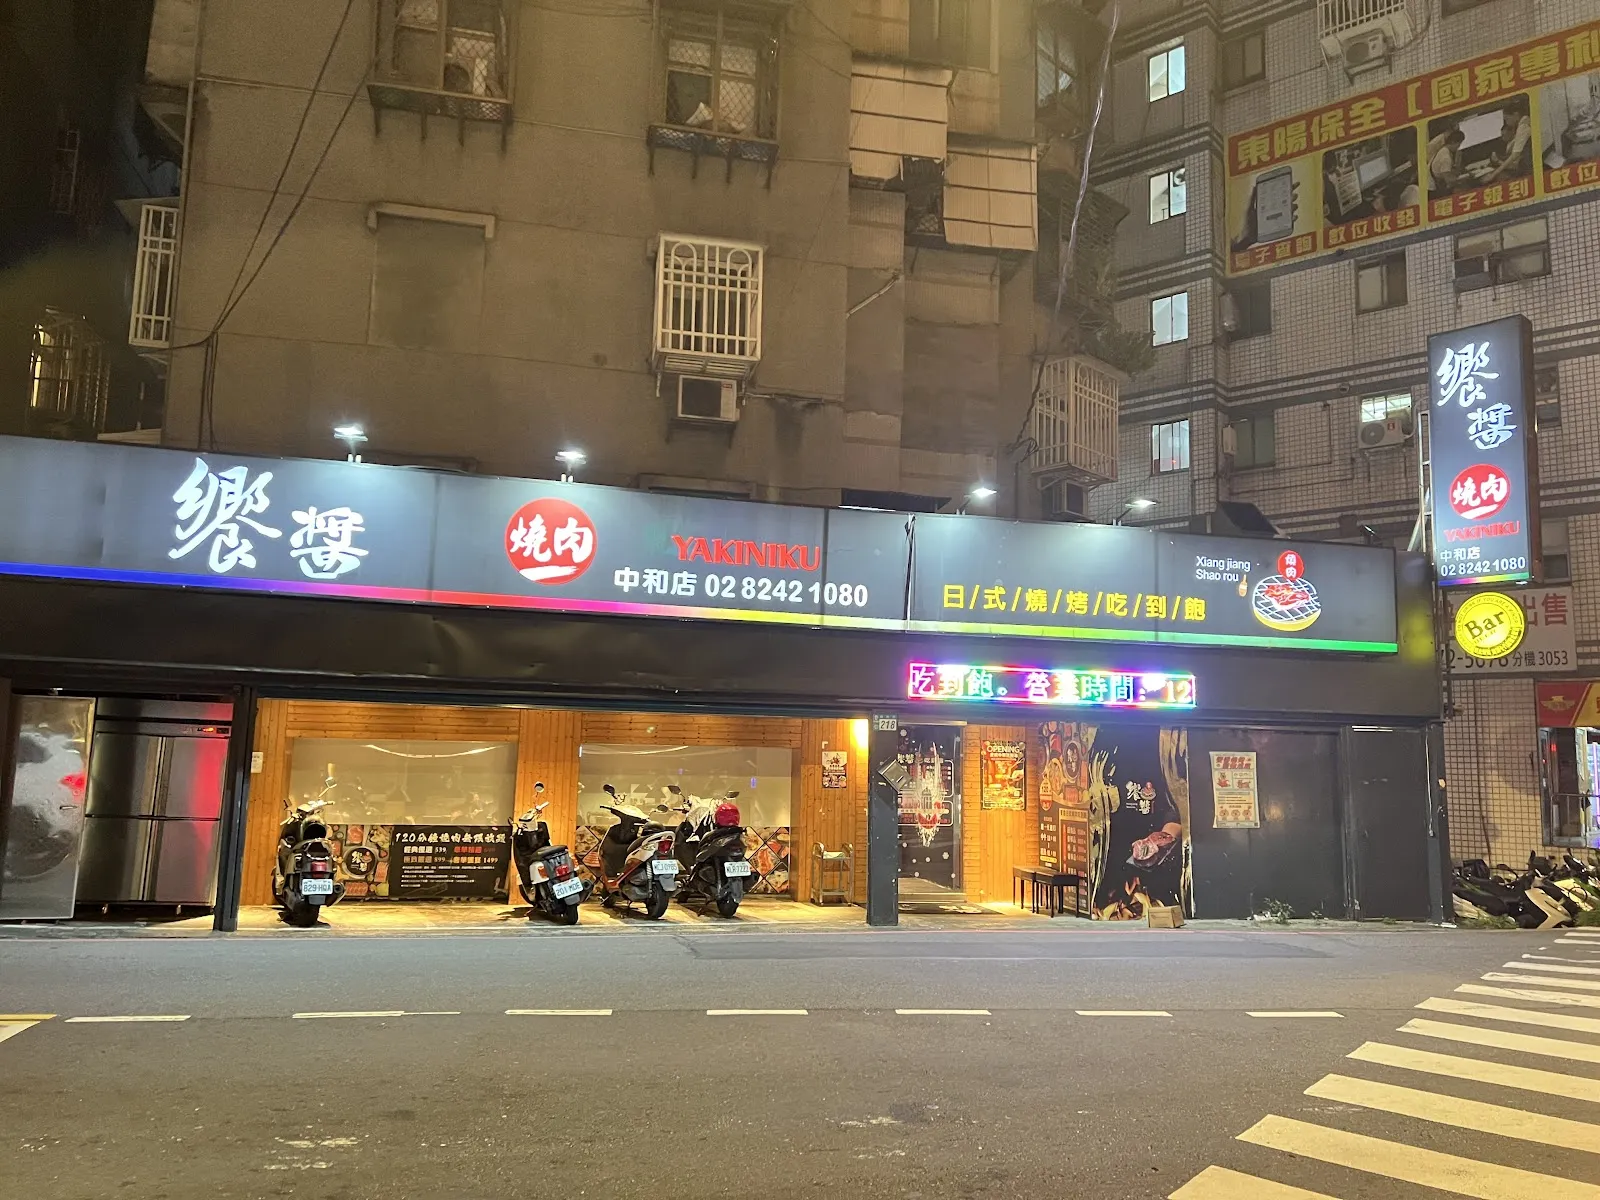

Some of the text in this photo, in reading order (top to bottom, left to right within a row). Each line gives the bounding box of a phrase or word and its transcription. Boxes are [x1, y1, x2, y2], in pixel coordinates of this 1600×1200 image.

[1452, 473, 1508, 508] 燒肉
[509, 513, 594, 563] 燒肉
[1443, 520, 1520, 543] YAKINIKU
[671, 534, 821, 572] YAKINIKU
[1440, 546, 1481, 562] 中和店
[1196, 556, 1251, 572] Xiang jiang
[1440, 557, 1526, 577] 02 8242 1080
[1196, 568, 1239, 582] Shao rou
[613, 566, 869, 608] 中和店 02 8242 1080
[1464, 611, 1504, 640] Bar
[1512, 651, 1536, 667] 分機
[1538, 650, 1569, 666] 3053
[880, 720, 896, 730] 218
[987, 745, 1020, 753] OPENING
